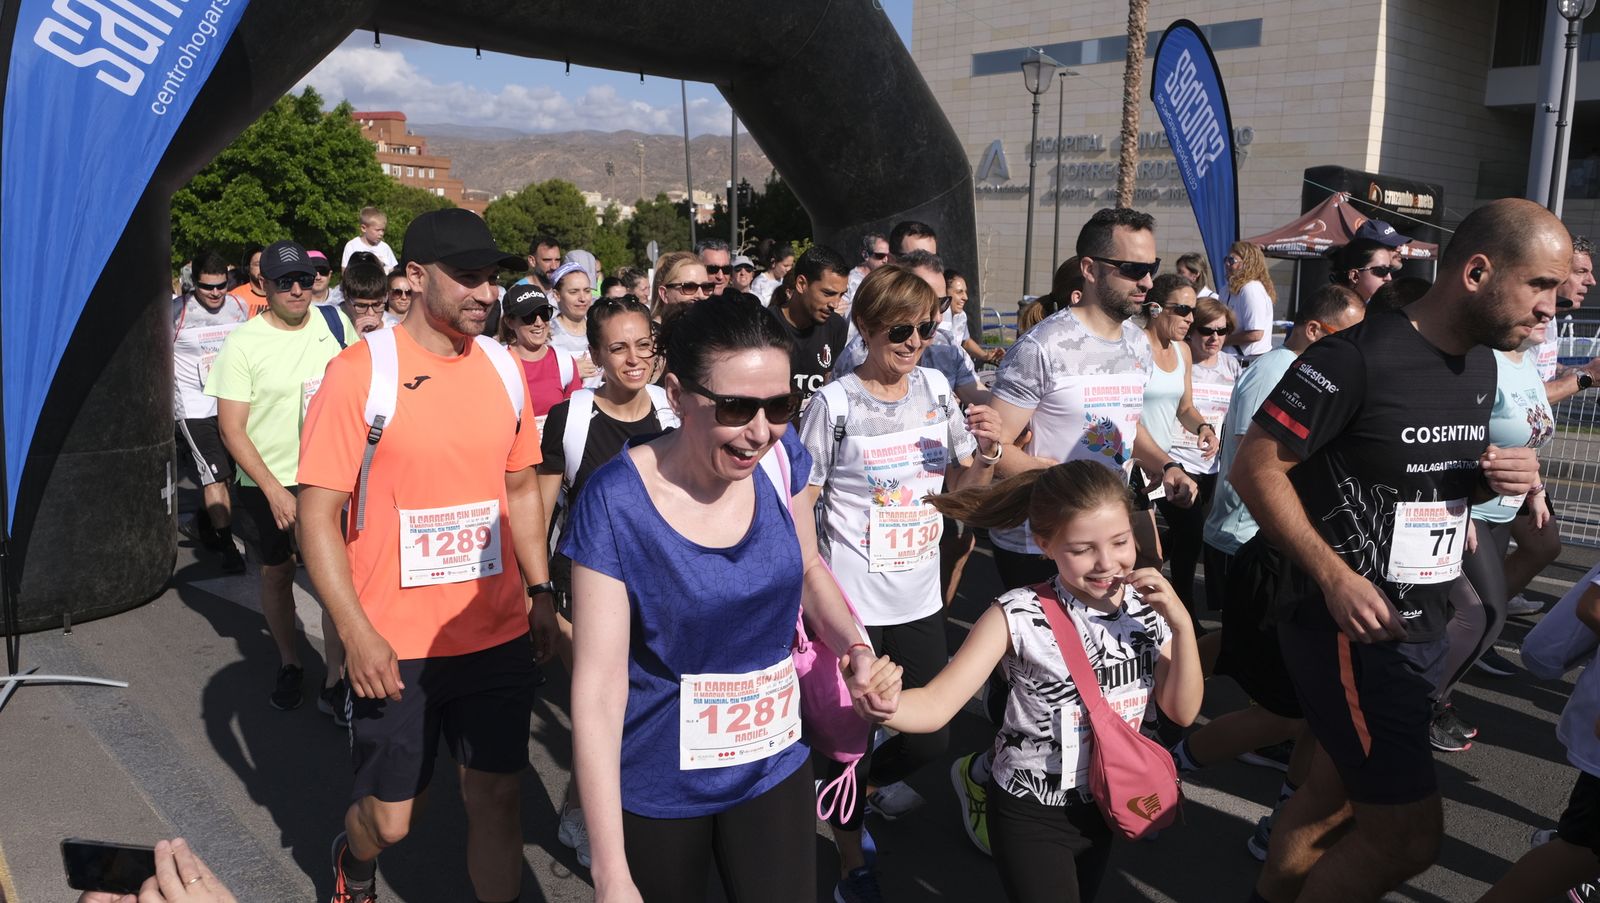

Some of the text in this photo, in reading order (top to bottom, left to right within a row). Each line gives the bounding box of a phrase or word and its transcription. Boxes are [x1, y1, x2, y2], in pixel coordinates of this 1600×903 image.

[516, 290, 546, 303] adidas
[1401, 425, 1485, 443] COSENTINO
[417, 512, 455, 524] CARRERA
[456, 509, 469, 520] SIN
[414, 525, 492, 558] 1289
[885, 522, 939, 550] 1130
[1429, 527, 1457, 557] 77
[442, 554, 471, 565] MANUEL
[704, 680, 754, 692] CARRERA
[756, 675, 772, 687] SIN
[699, 685, 794, 735] 1287
[735, 728, 768, 743] RAQUEL
